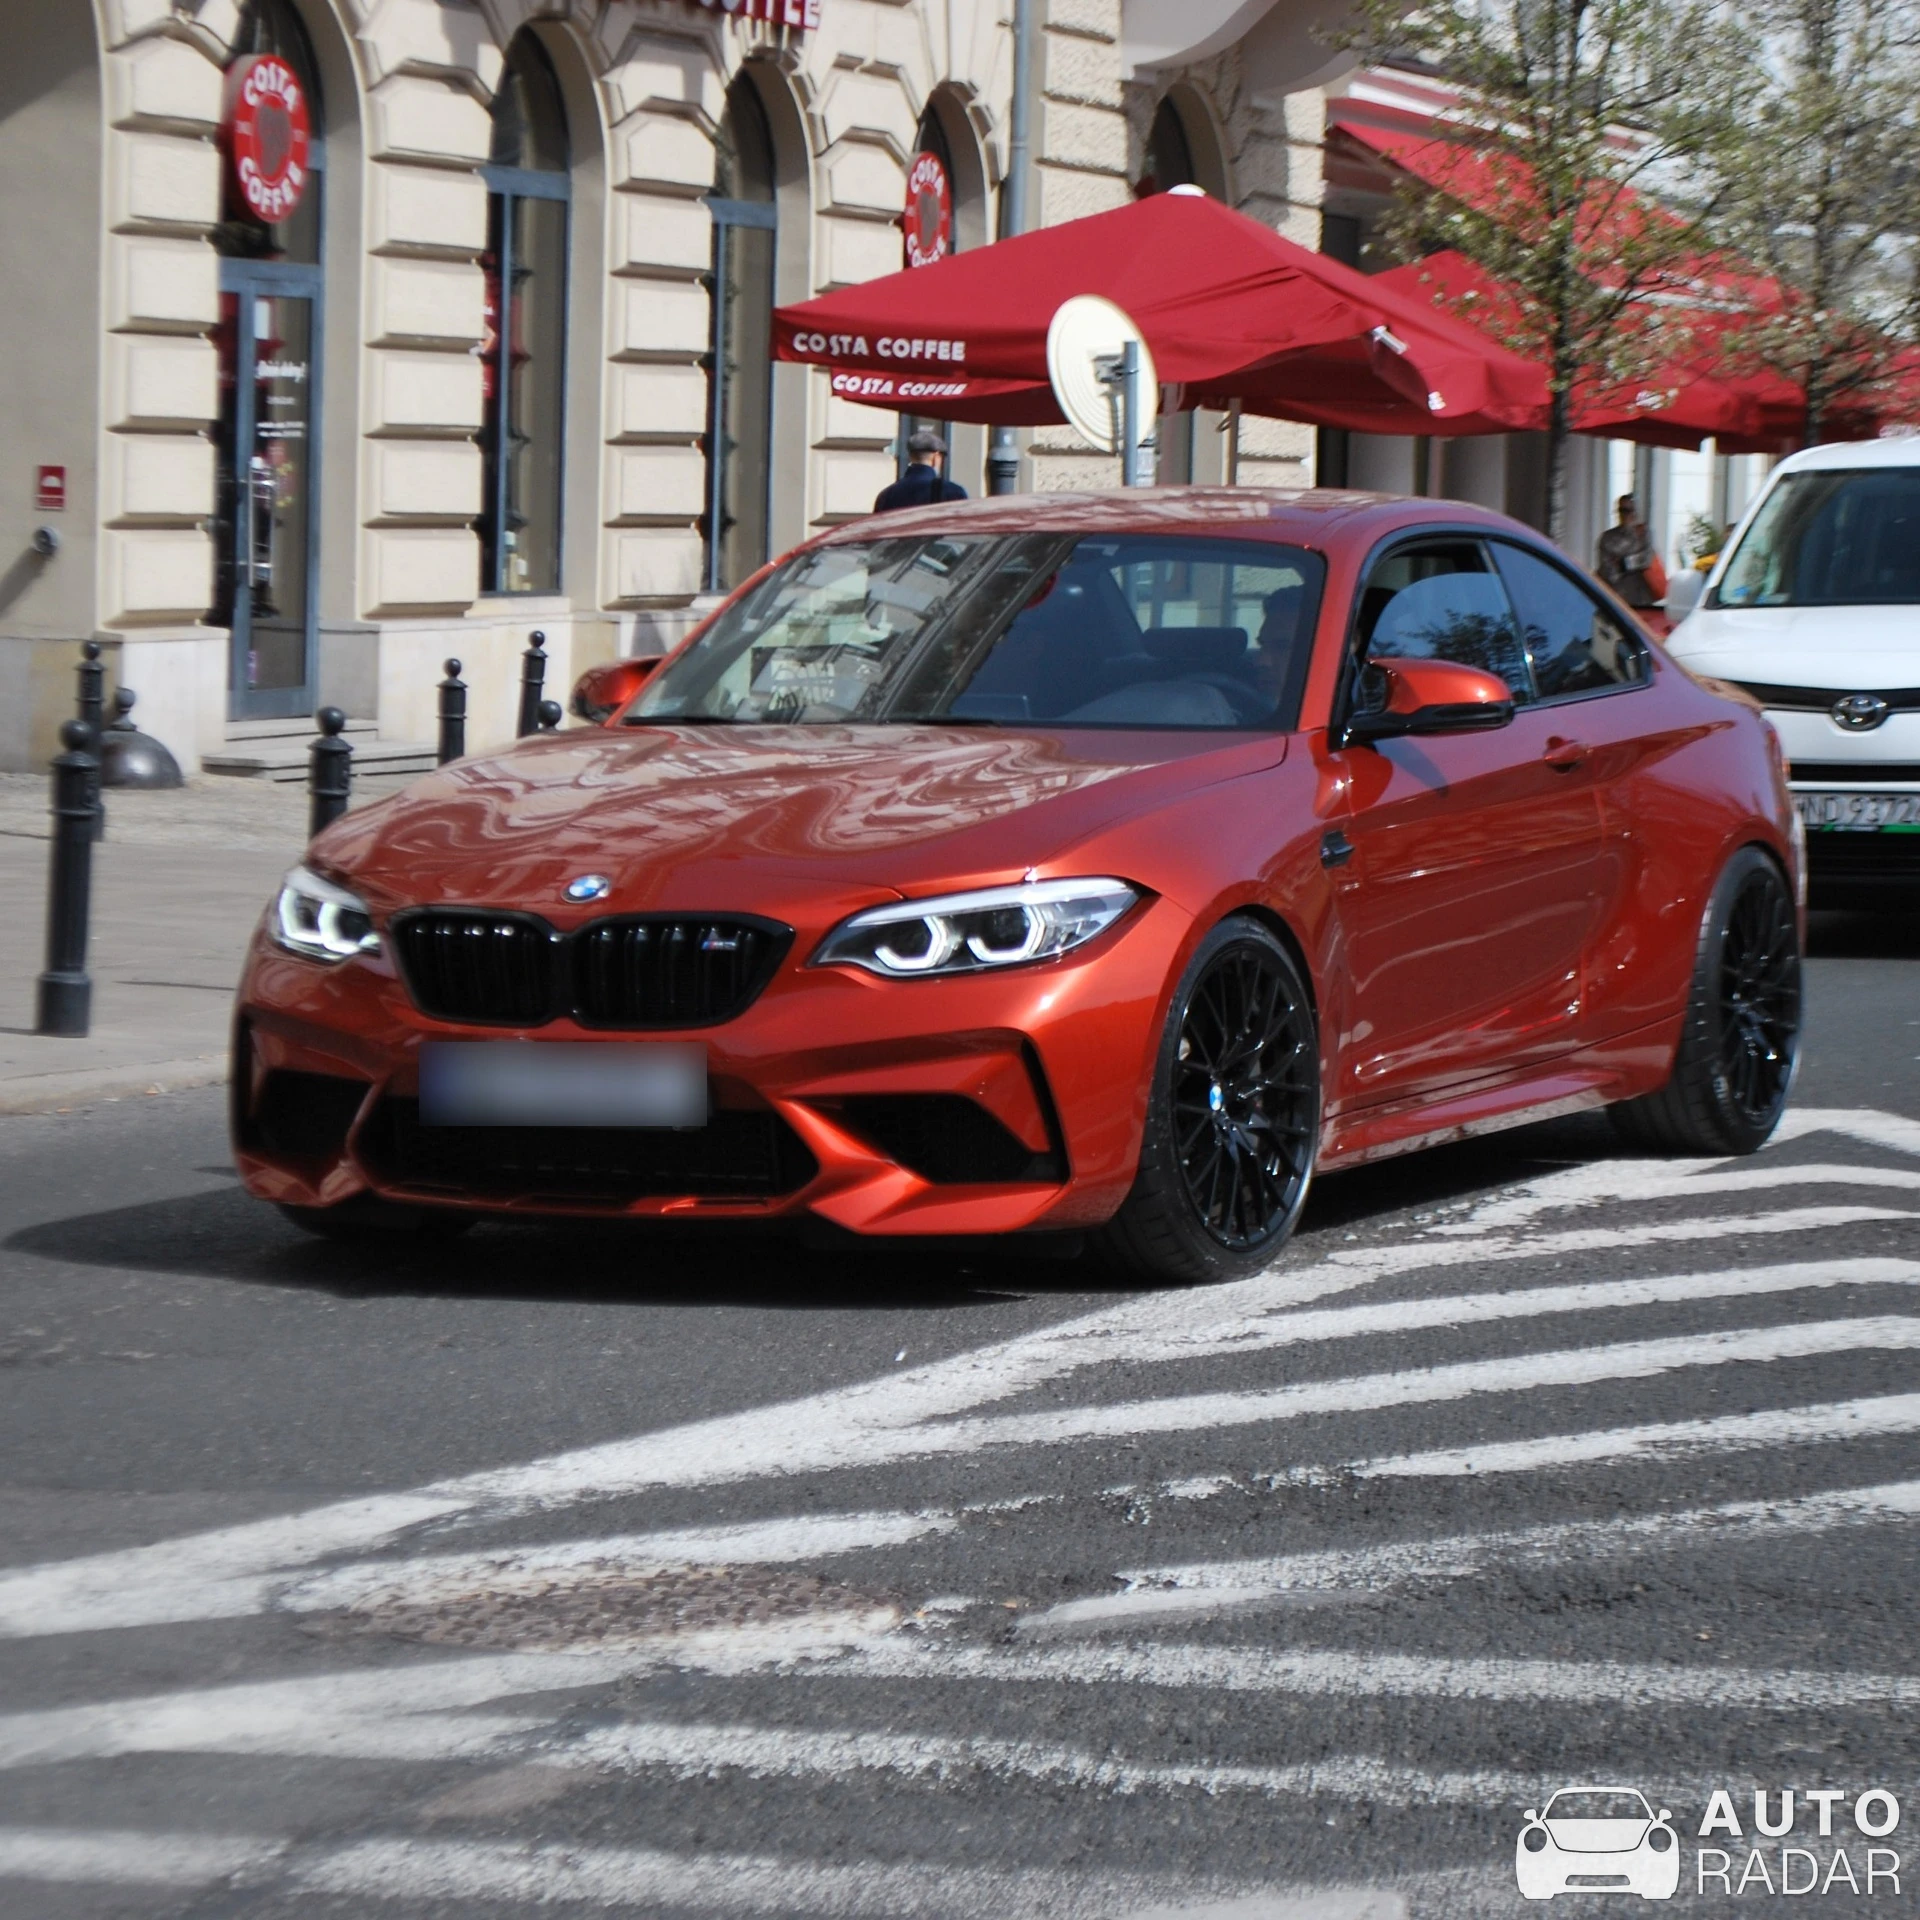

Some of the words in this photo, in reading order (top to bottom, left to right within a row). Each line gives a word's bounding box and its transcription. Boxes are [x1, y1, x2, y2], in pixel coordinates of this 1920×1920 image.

[244, 62, 297, 113] COSTA
[911, 157, 945, 197] COSTA
[793, 332, 869, 356] COSTA
[876, 337, 966, 361] COFFEE
[832, 374, 894, 395] COSTA
[898, 382, 968, 396] COFFEE
